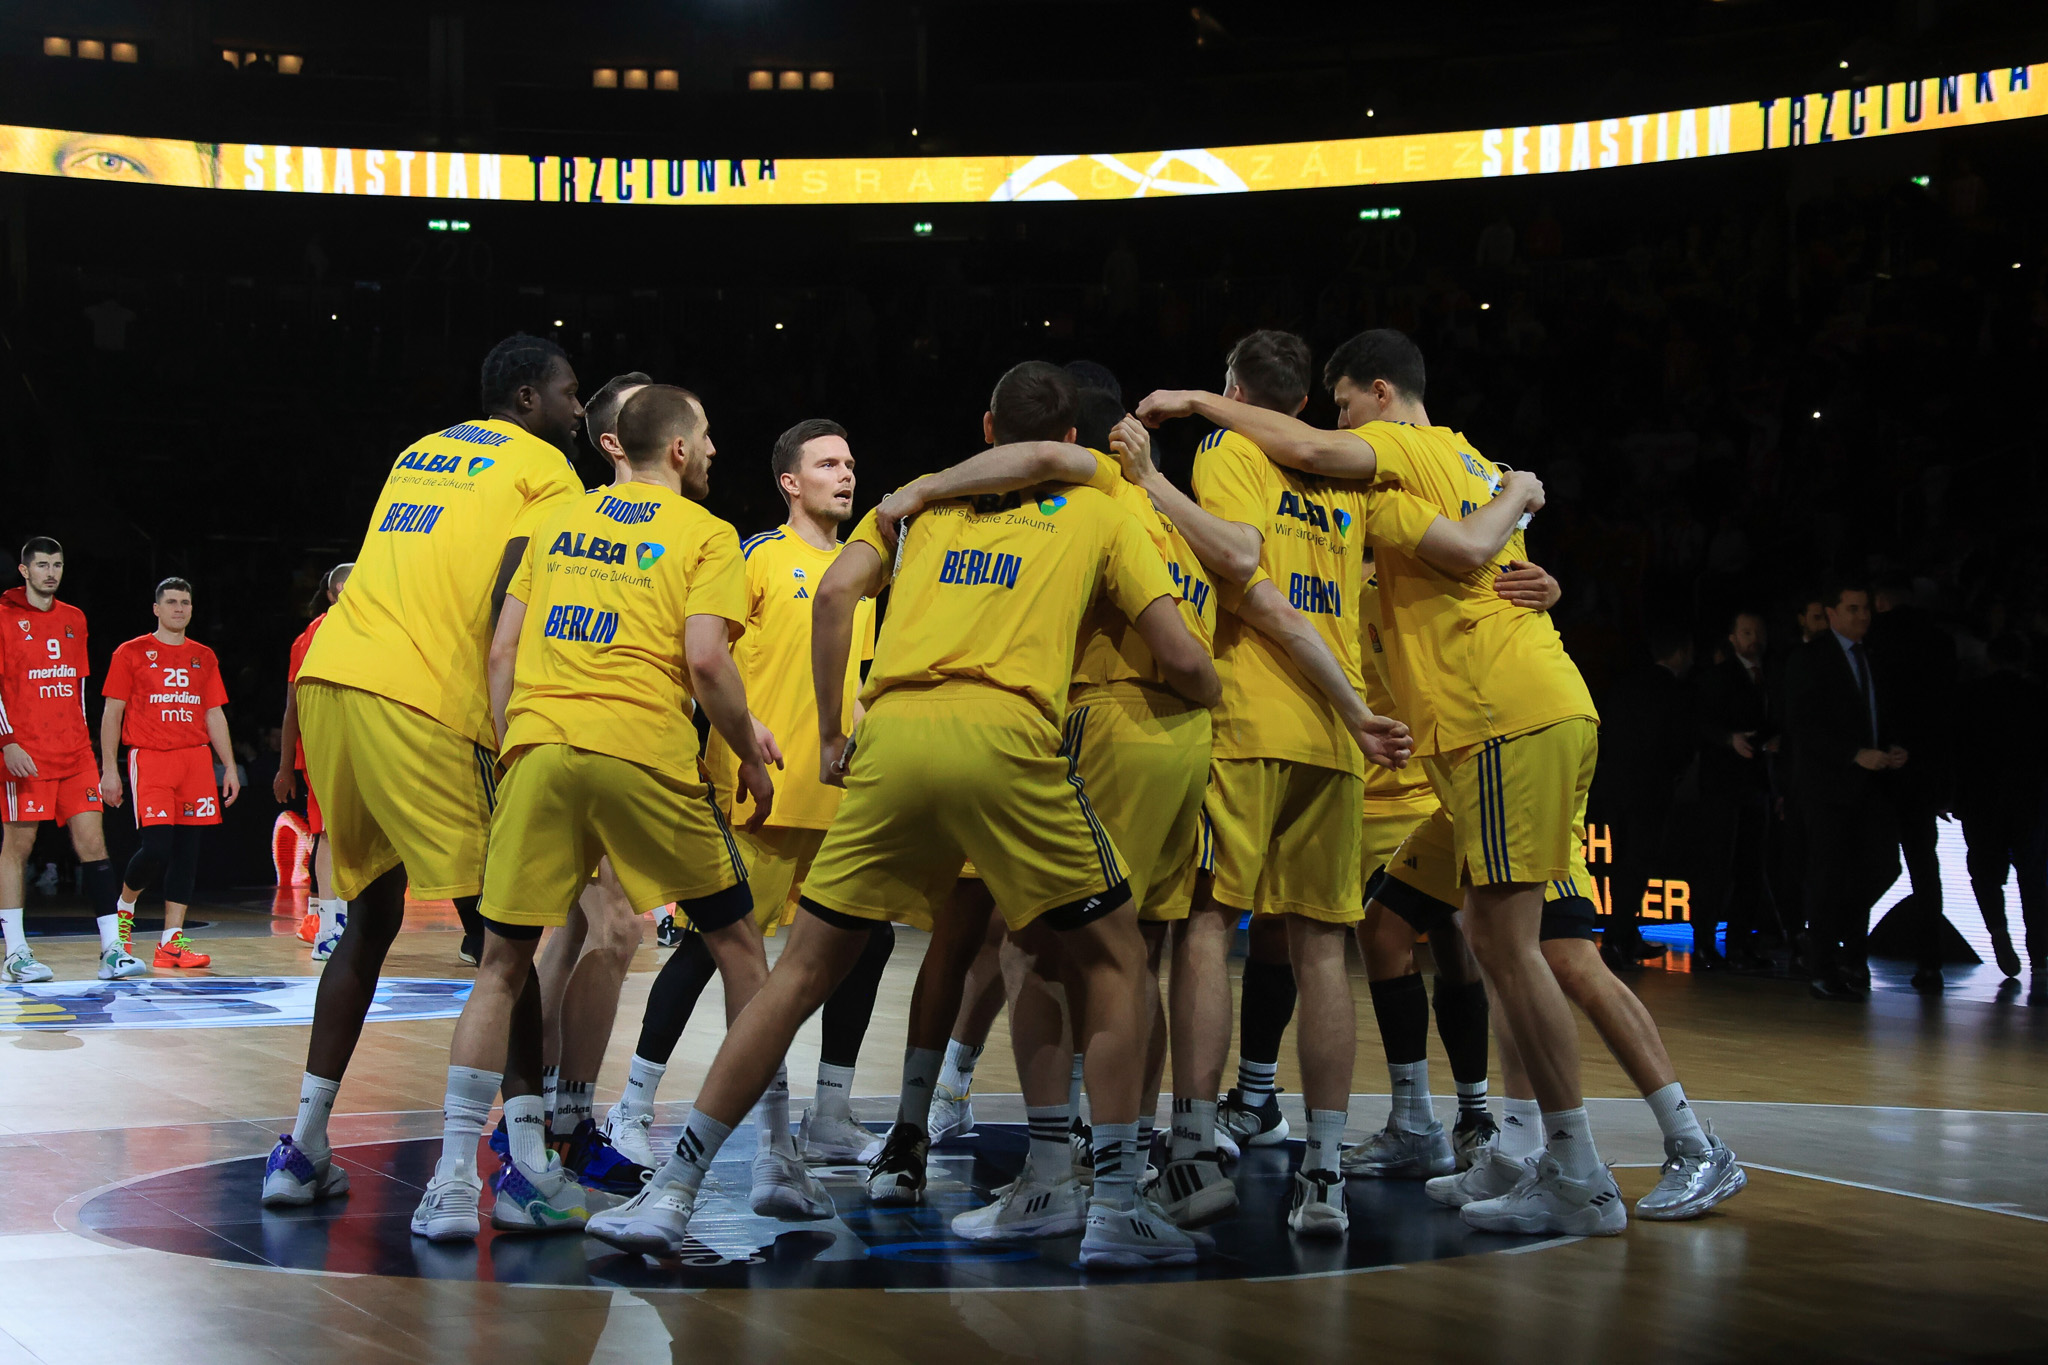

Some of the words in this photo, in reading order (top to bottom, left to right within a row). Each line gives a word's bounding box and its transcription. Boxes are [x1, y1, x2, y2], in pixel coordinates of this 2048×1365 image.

[1482, 104, 1731, 177] SEBASTIAN
[243, 143, 501, 200] SEBASTIAN
[395, 451, 463, 474] ALBA
[402, 474, 422, 485] sind
[422, 478, 437, 487] die
[437, 477, 476, 493] Zukunft.
[378, 502, 445, 534] BERLIN
[595, 495, 661, 525] THOMAS
[933, 505, 954, 517] Wir
[1005, 514, 1059, 534] Zukunft.
[1275, 522, 1293, 537] Wir
[548, 531, 628, 566] ALBA
[546, 561, 562, 574] Wir
[564, 563, 587, 576] sind
[590, 567, 608, 581] die
[609, 570, 655, 589] Zukunft.
[938, 549, 1022, 590] BERLIN
[544, 604, 619, 644] BERLIN
[46, 638, 61, 660] 9
[163, 667, 190, 688] 26
[39, 681, 74, 698] mts
[149, 691, 201, 705] meridian
[161, 707, 193, 722] mts
[196, 796, 216, 818] 26
[557, 1104, 590, 1115] adidas
